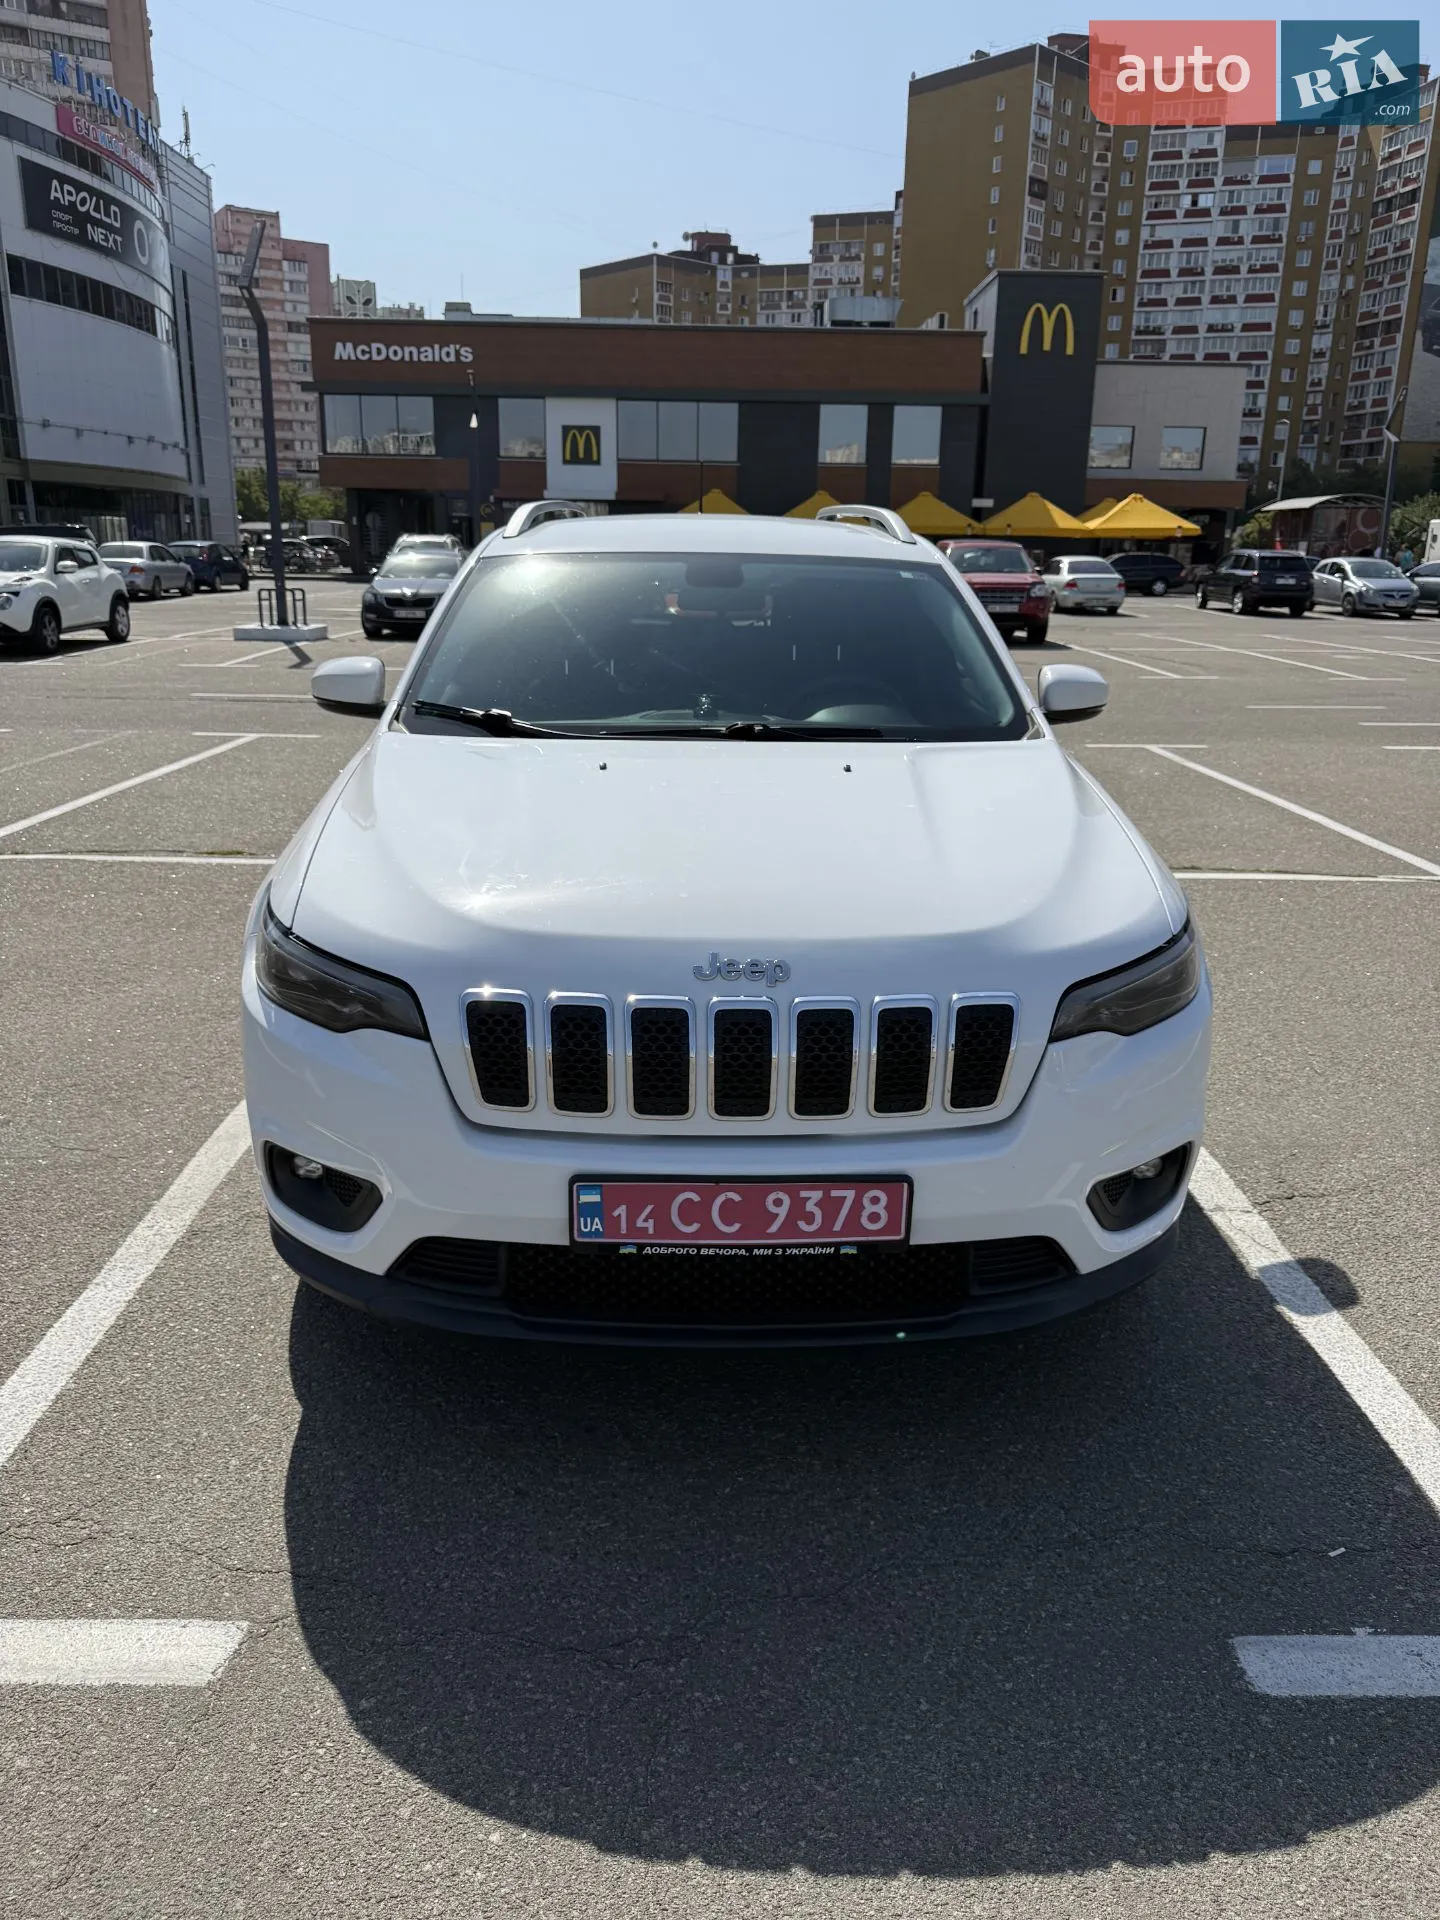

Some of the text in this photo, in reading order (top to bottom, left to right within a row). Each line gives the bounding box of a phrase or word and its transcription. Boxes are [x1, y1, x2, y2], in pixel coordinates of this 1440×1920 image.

[50, 179, 120, 228] APOLLO
[51, 209, 73, 223] СПОРТ
[87, 223, 122, 253] NEXT
[334, 342, 474, 362] McDonald's
[692, 952, 791, 988] Jeep
[612, 1190, 889, 1234] 14 CC 9378
[580, 1217, 603, 1233] UA
[642, 1246, 697, 1255] ДОБРОГО
[700, 1247, 750, 1257] ВЕЧОРА,
[752, 1247, 773, 1256] МИ
[784, 1245, 836, 1256] УКРАЇНИ
